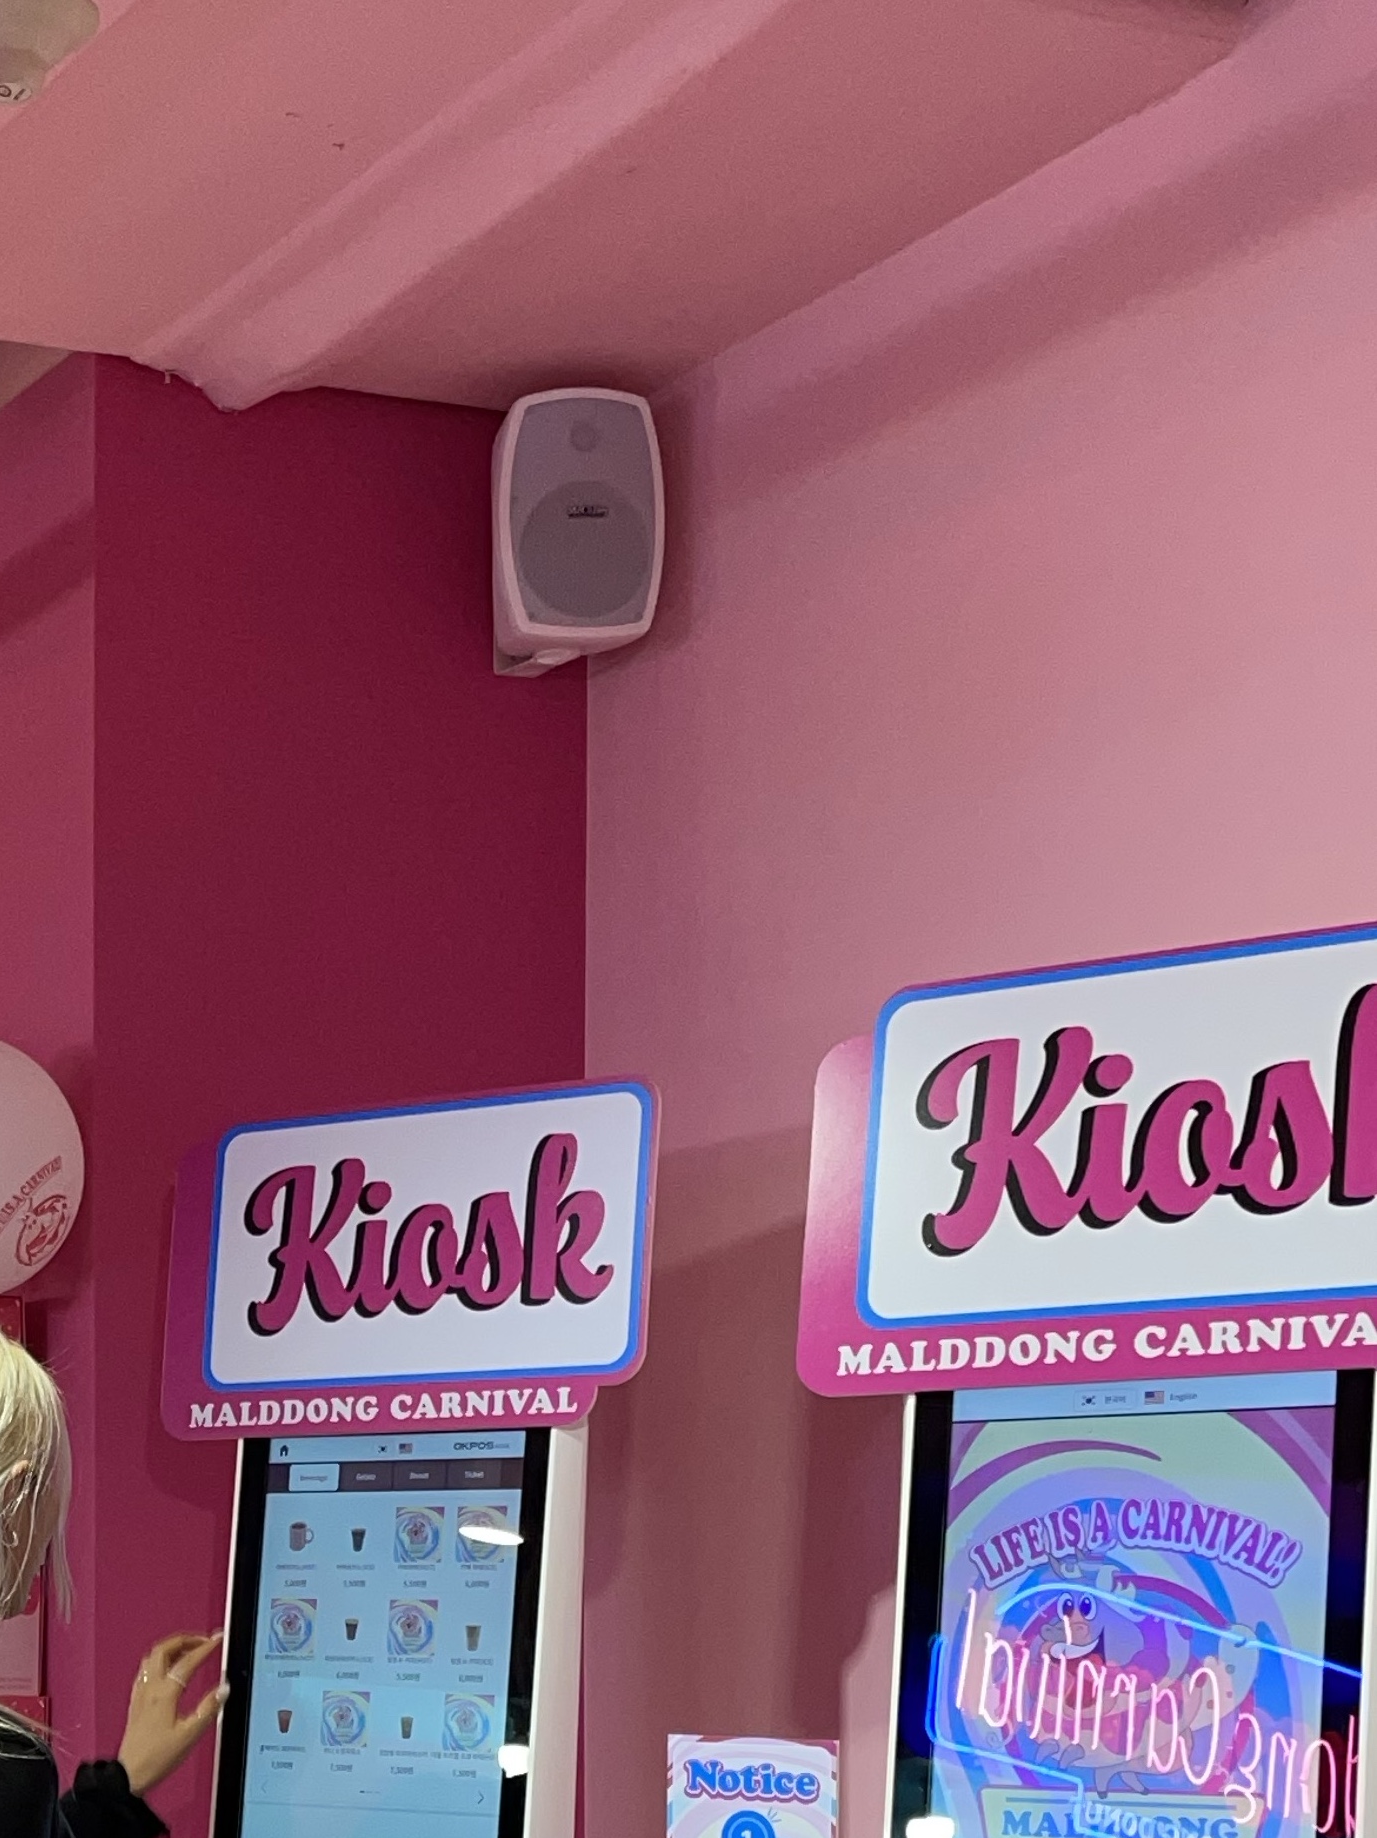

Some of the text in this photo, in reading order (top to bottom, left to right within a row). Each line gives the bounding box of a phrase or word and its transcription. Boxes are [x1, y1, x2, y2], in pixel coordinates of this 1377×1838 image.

[243, 1133, 614, 1337] Kiosk
[836, 1328, 1117, 1377] MALDDONG
[188, 1386, 578, 1430] MALDDONG CARNIVAL
[974, 1498, 1301, 1581] LIFE IS A CARNIVAL!
[685, 1759, 820, 1803] Notice
